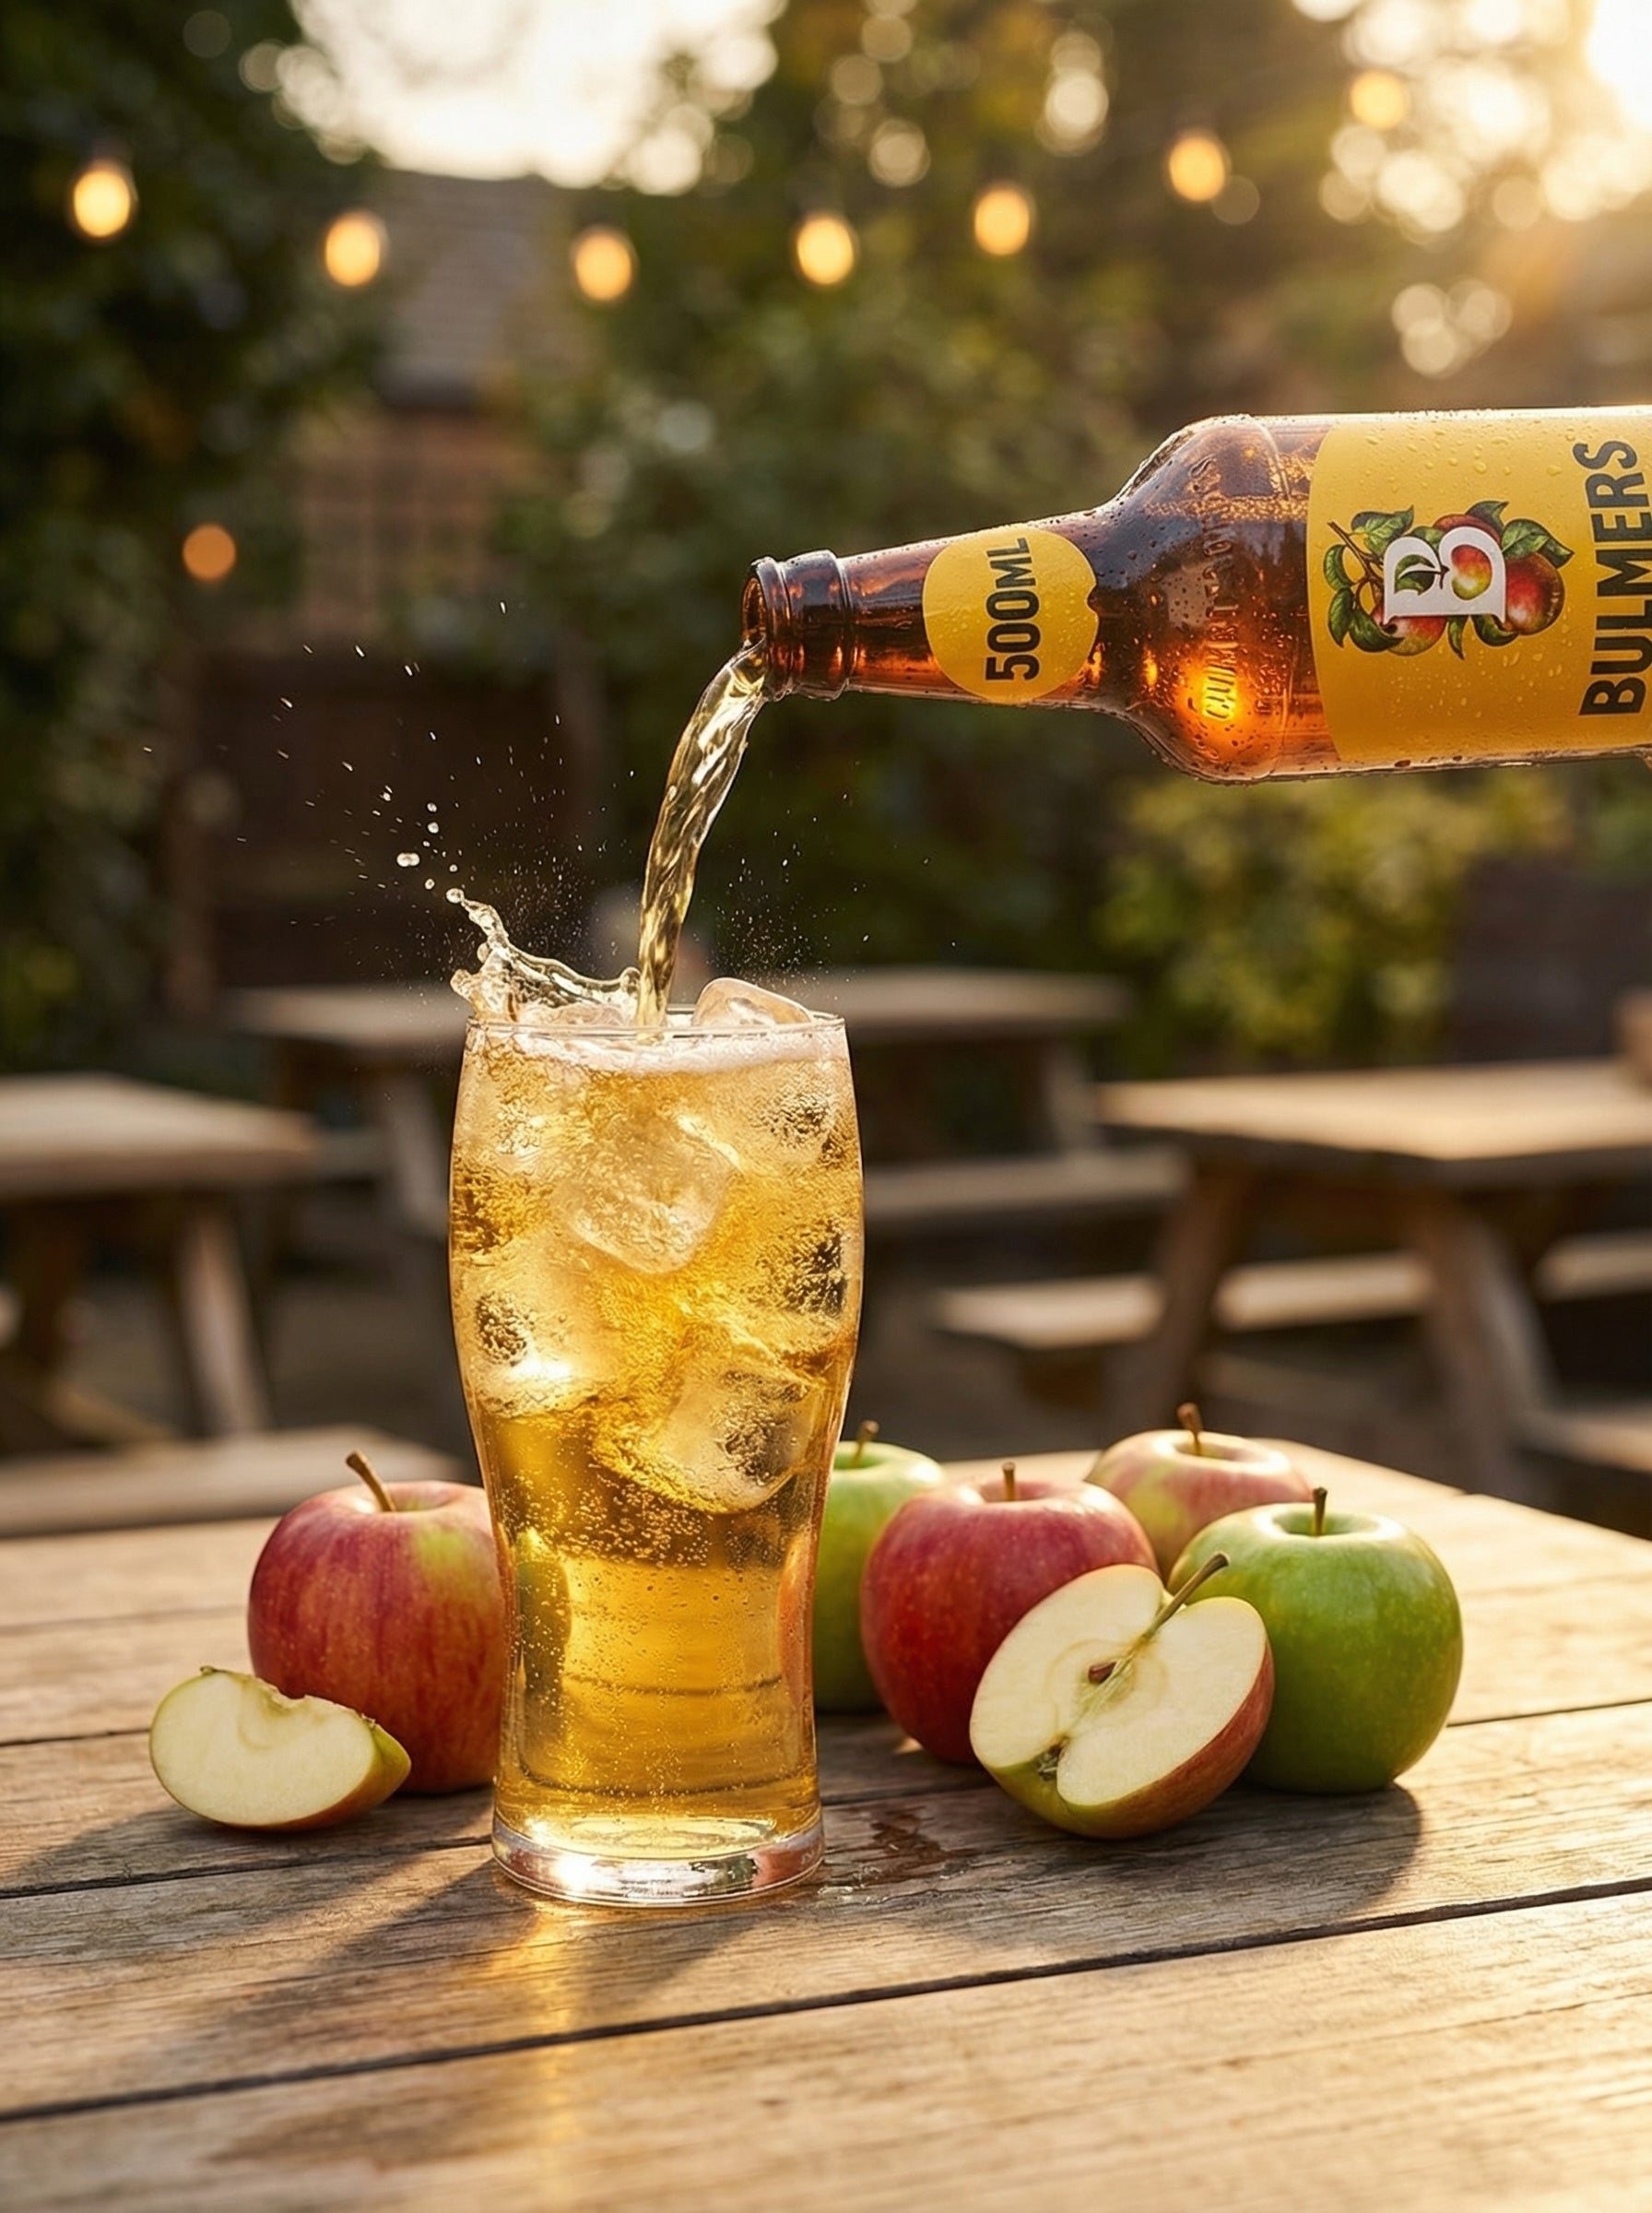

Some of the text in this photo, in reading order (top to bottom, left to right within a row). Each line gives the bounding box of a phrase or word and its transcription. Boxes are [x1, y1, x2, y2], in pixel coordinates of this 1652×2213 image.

[985, 537, 1041, 680] 500ML
[1384, 526, 1507, 625] B
[1572, 440, 1652, 716] BULMERS
